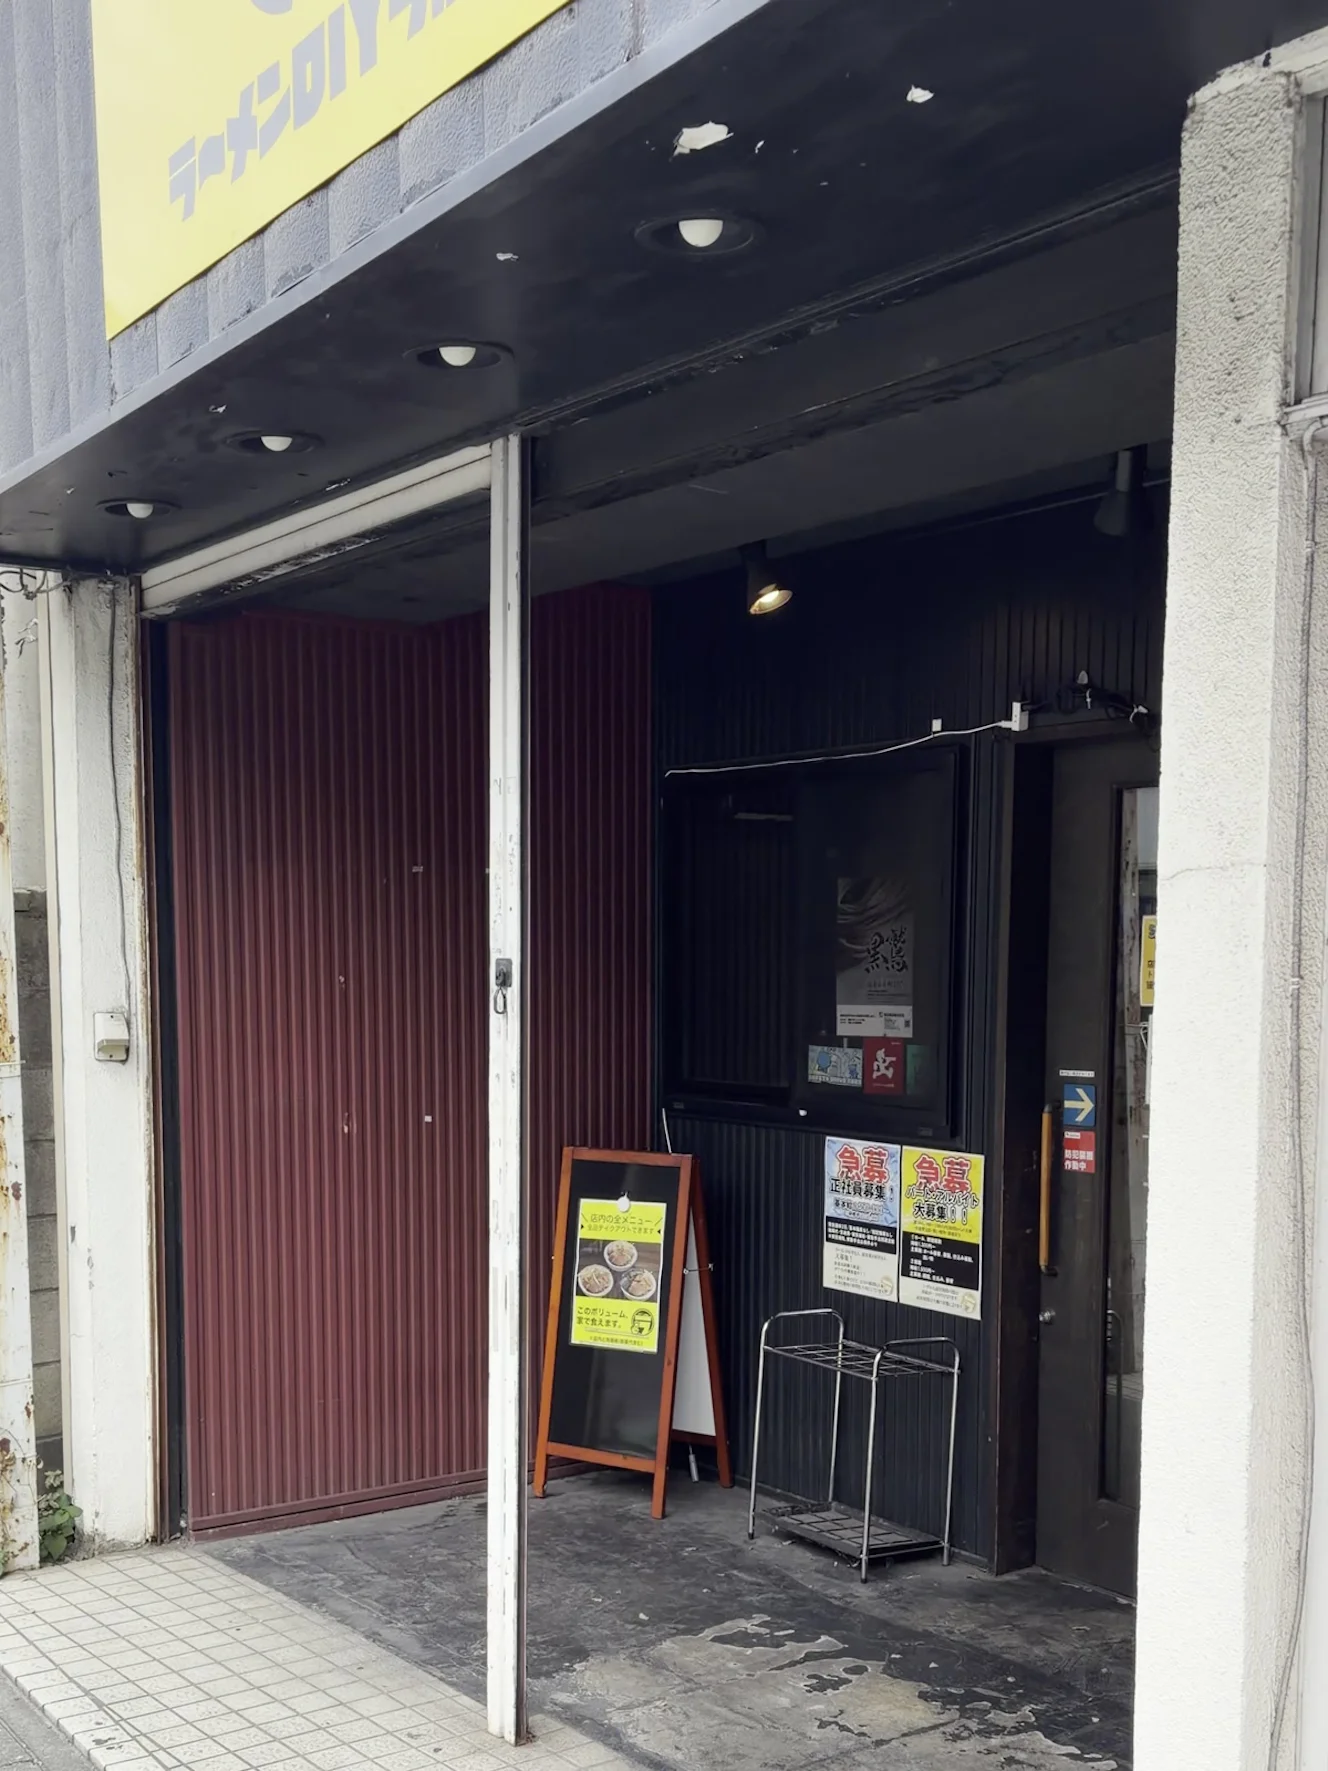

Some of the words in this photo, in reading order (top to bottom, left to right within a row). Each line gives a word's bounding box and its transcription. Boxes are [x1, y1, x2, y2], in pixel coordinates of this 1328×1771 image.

[836, 1143, 890, 1183] 急募
[914, 1154, 971, 1193] 急募
[591, 1213, 653, 1225] 店内の全メニュー
